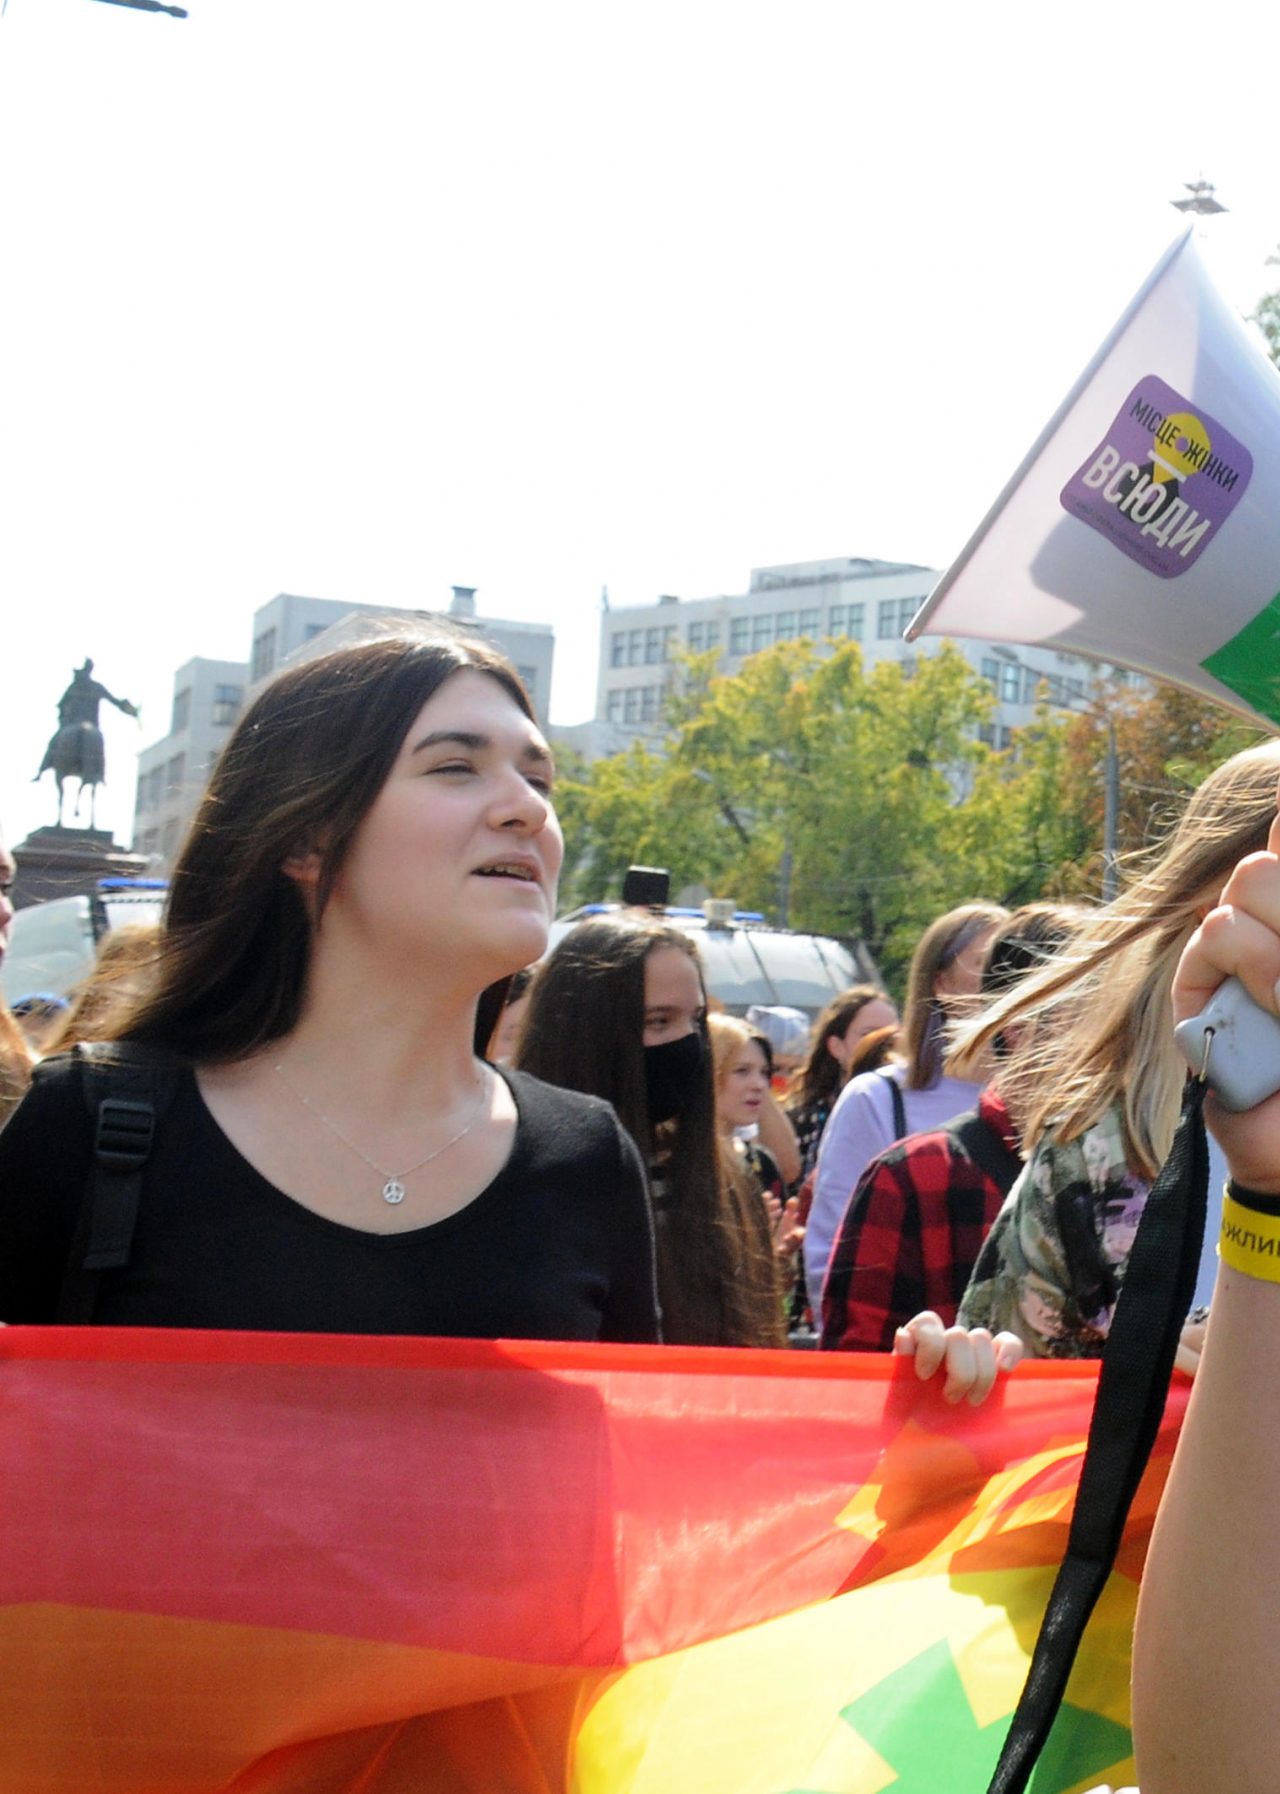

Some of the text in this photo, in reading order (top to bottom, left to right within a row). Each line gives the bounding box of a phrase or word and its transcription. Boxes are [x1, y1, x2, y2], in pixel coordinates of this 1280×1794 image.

[1129, 397, 1240, 493] МІСЦЕ ЖІНКИ
[1081, 445, 1211, 558] ВСЮДИ
